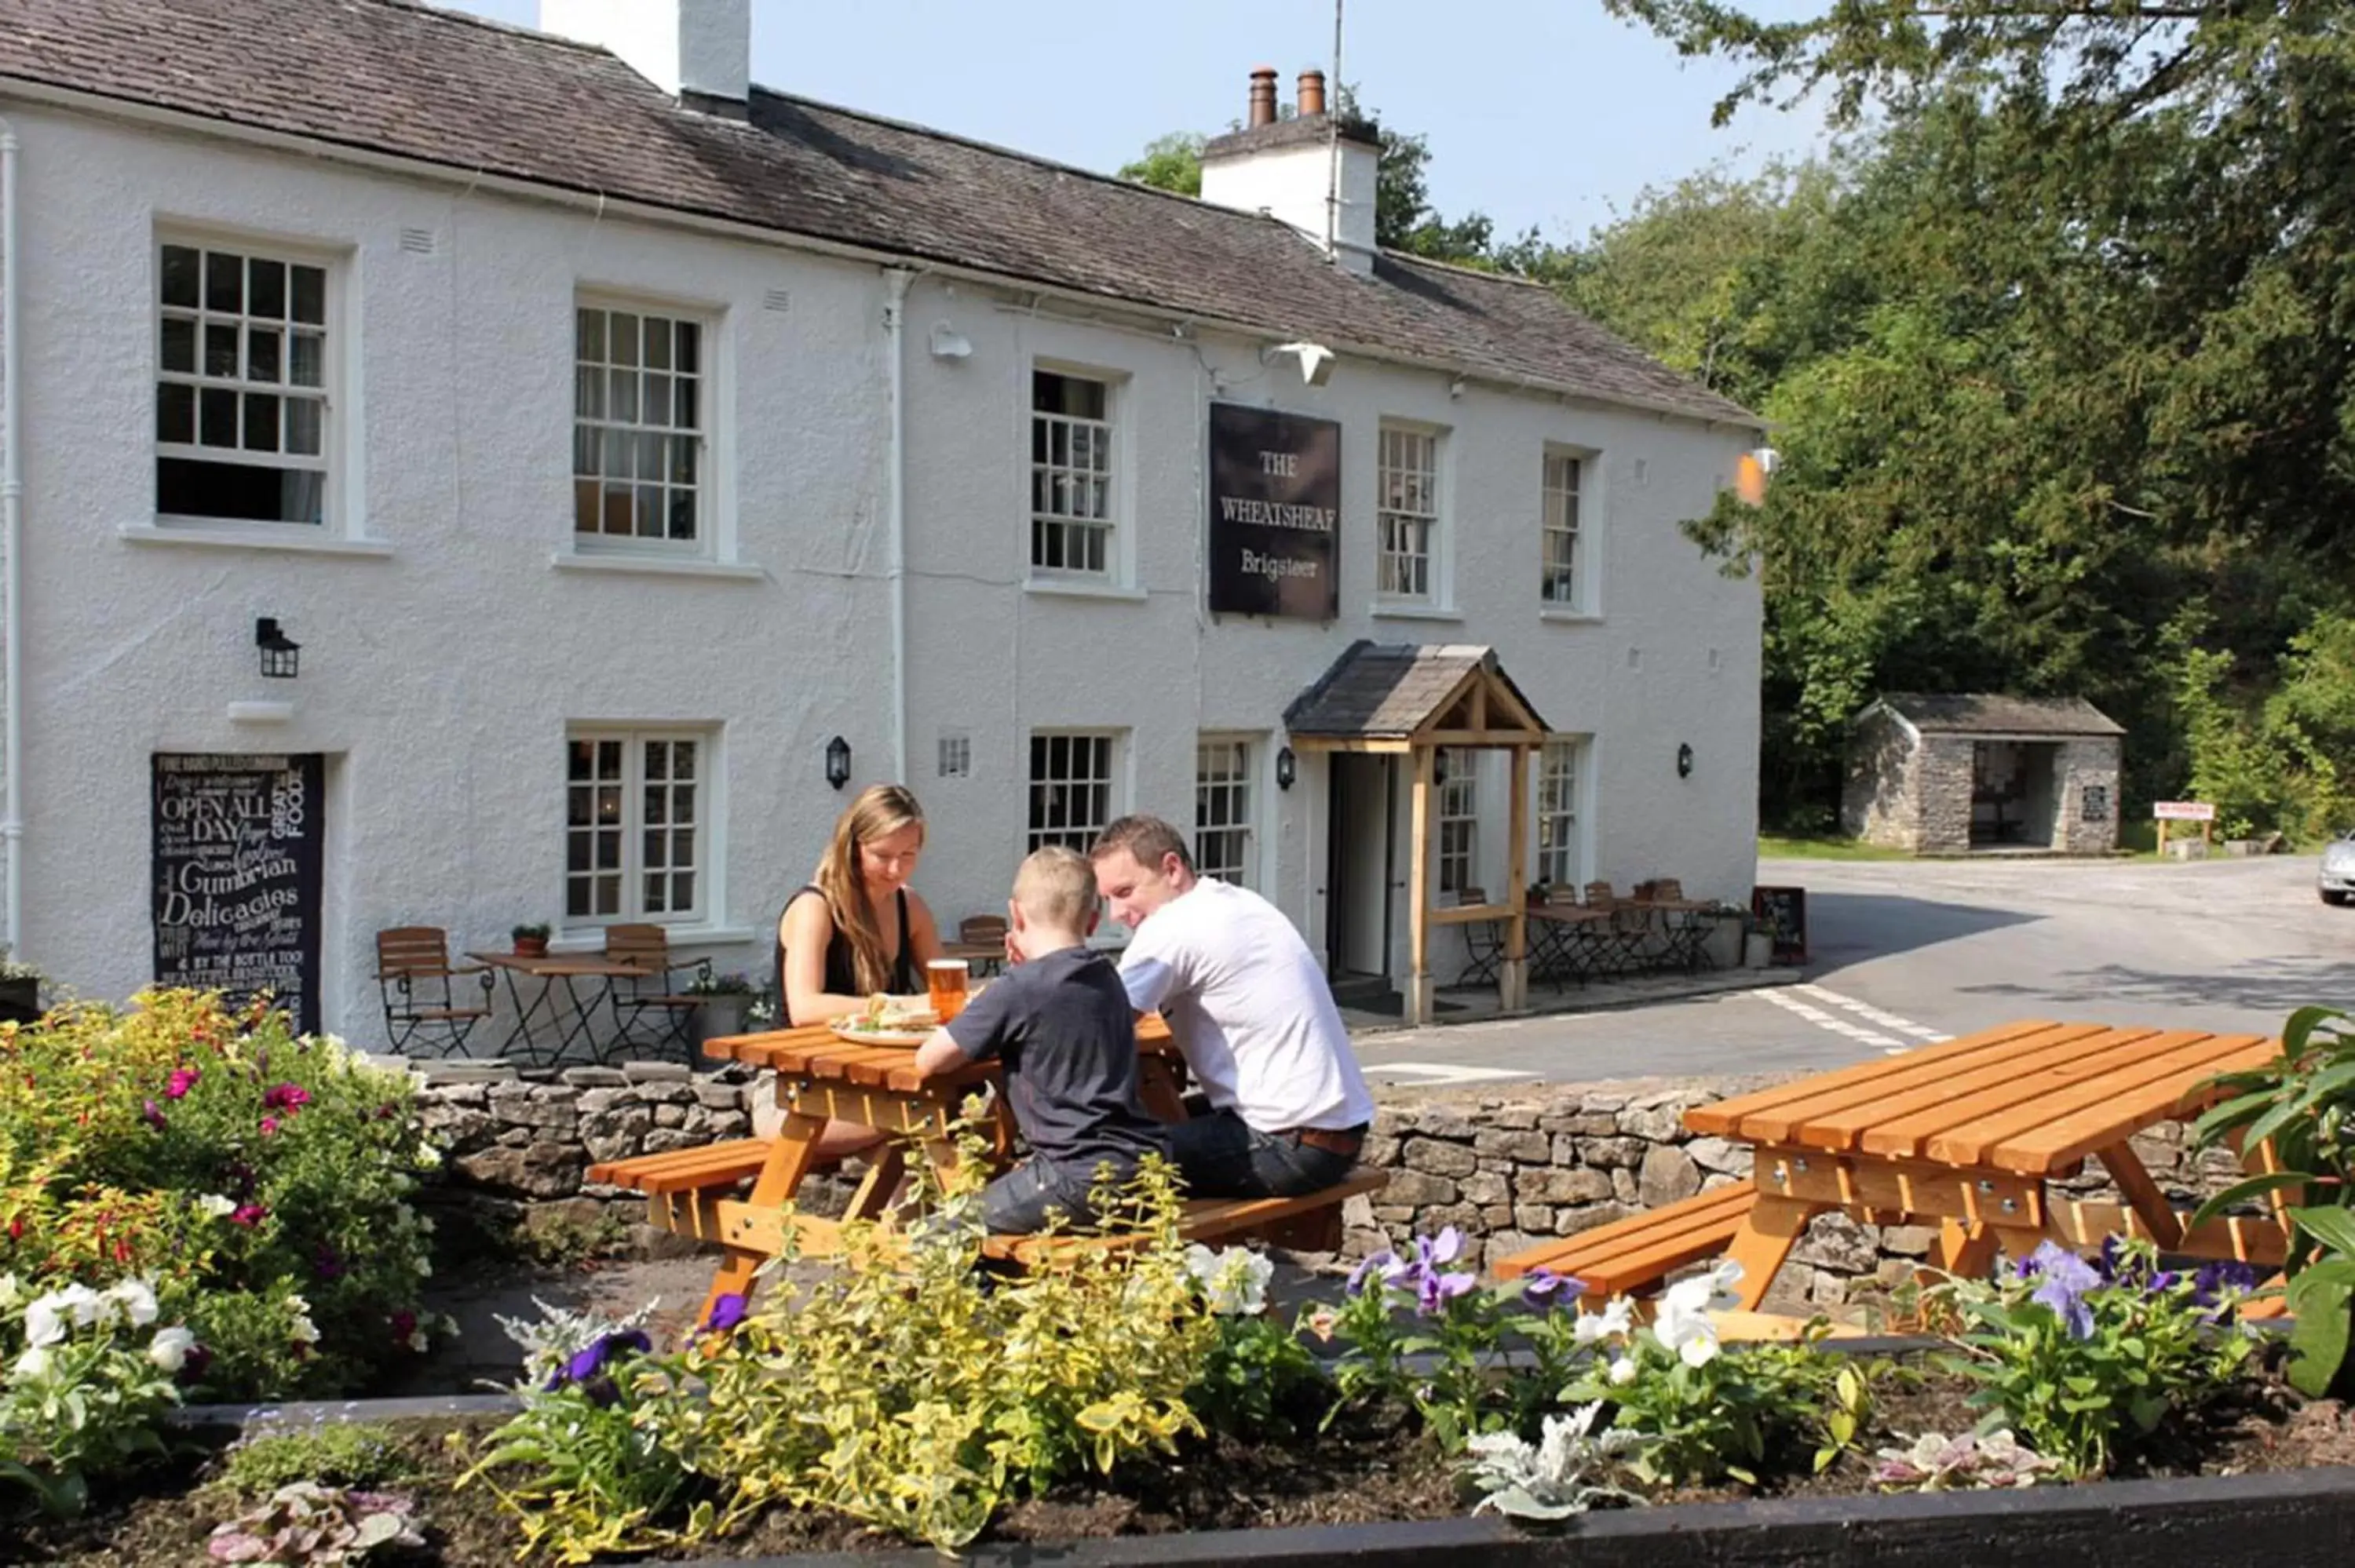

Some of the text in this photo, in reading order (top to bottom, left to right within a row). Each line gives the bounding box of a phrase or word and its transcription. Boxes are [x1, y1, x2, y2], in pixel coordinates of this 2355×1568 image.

[1259, 450, 1298, 478] THE
[1220, 495, 1336, 532] WHEATSHEAF
[1240, 548, 1318, 582] Brigsteer
[161, 796, 272, 820] OPEN ALL
[193, 819, 243, 841] DAY
[179, 859, 298, 894] Cumbrian
[161, 888, 298, 928] Delicacies
